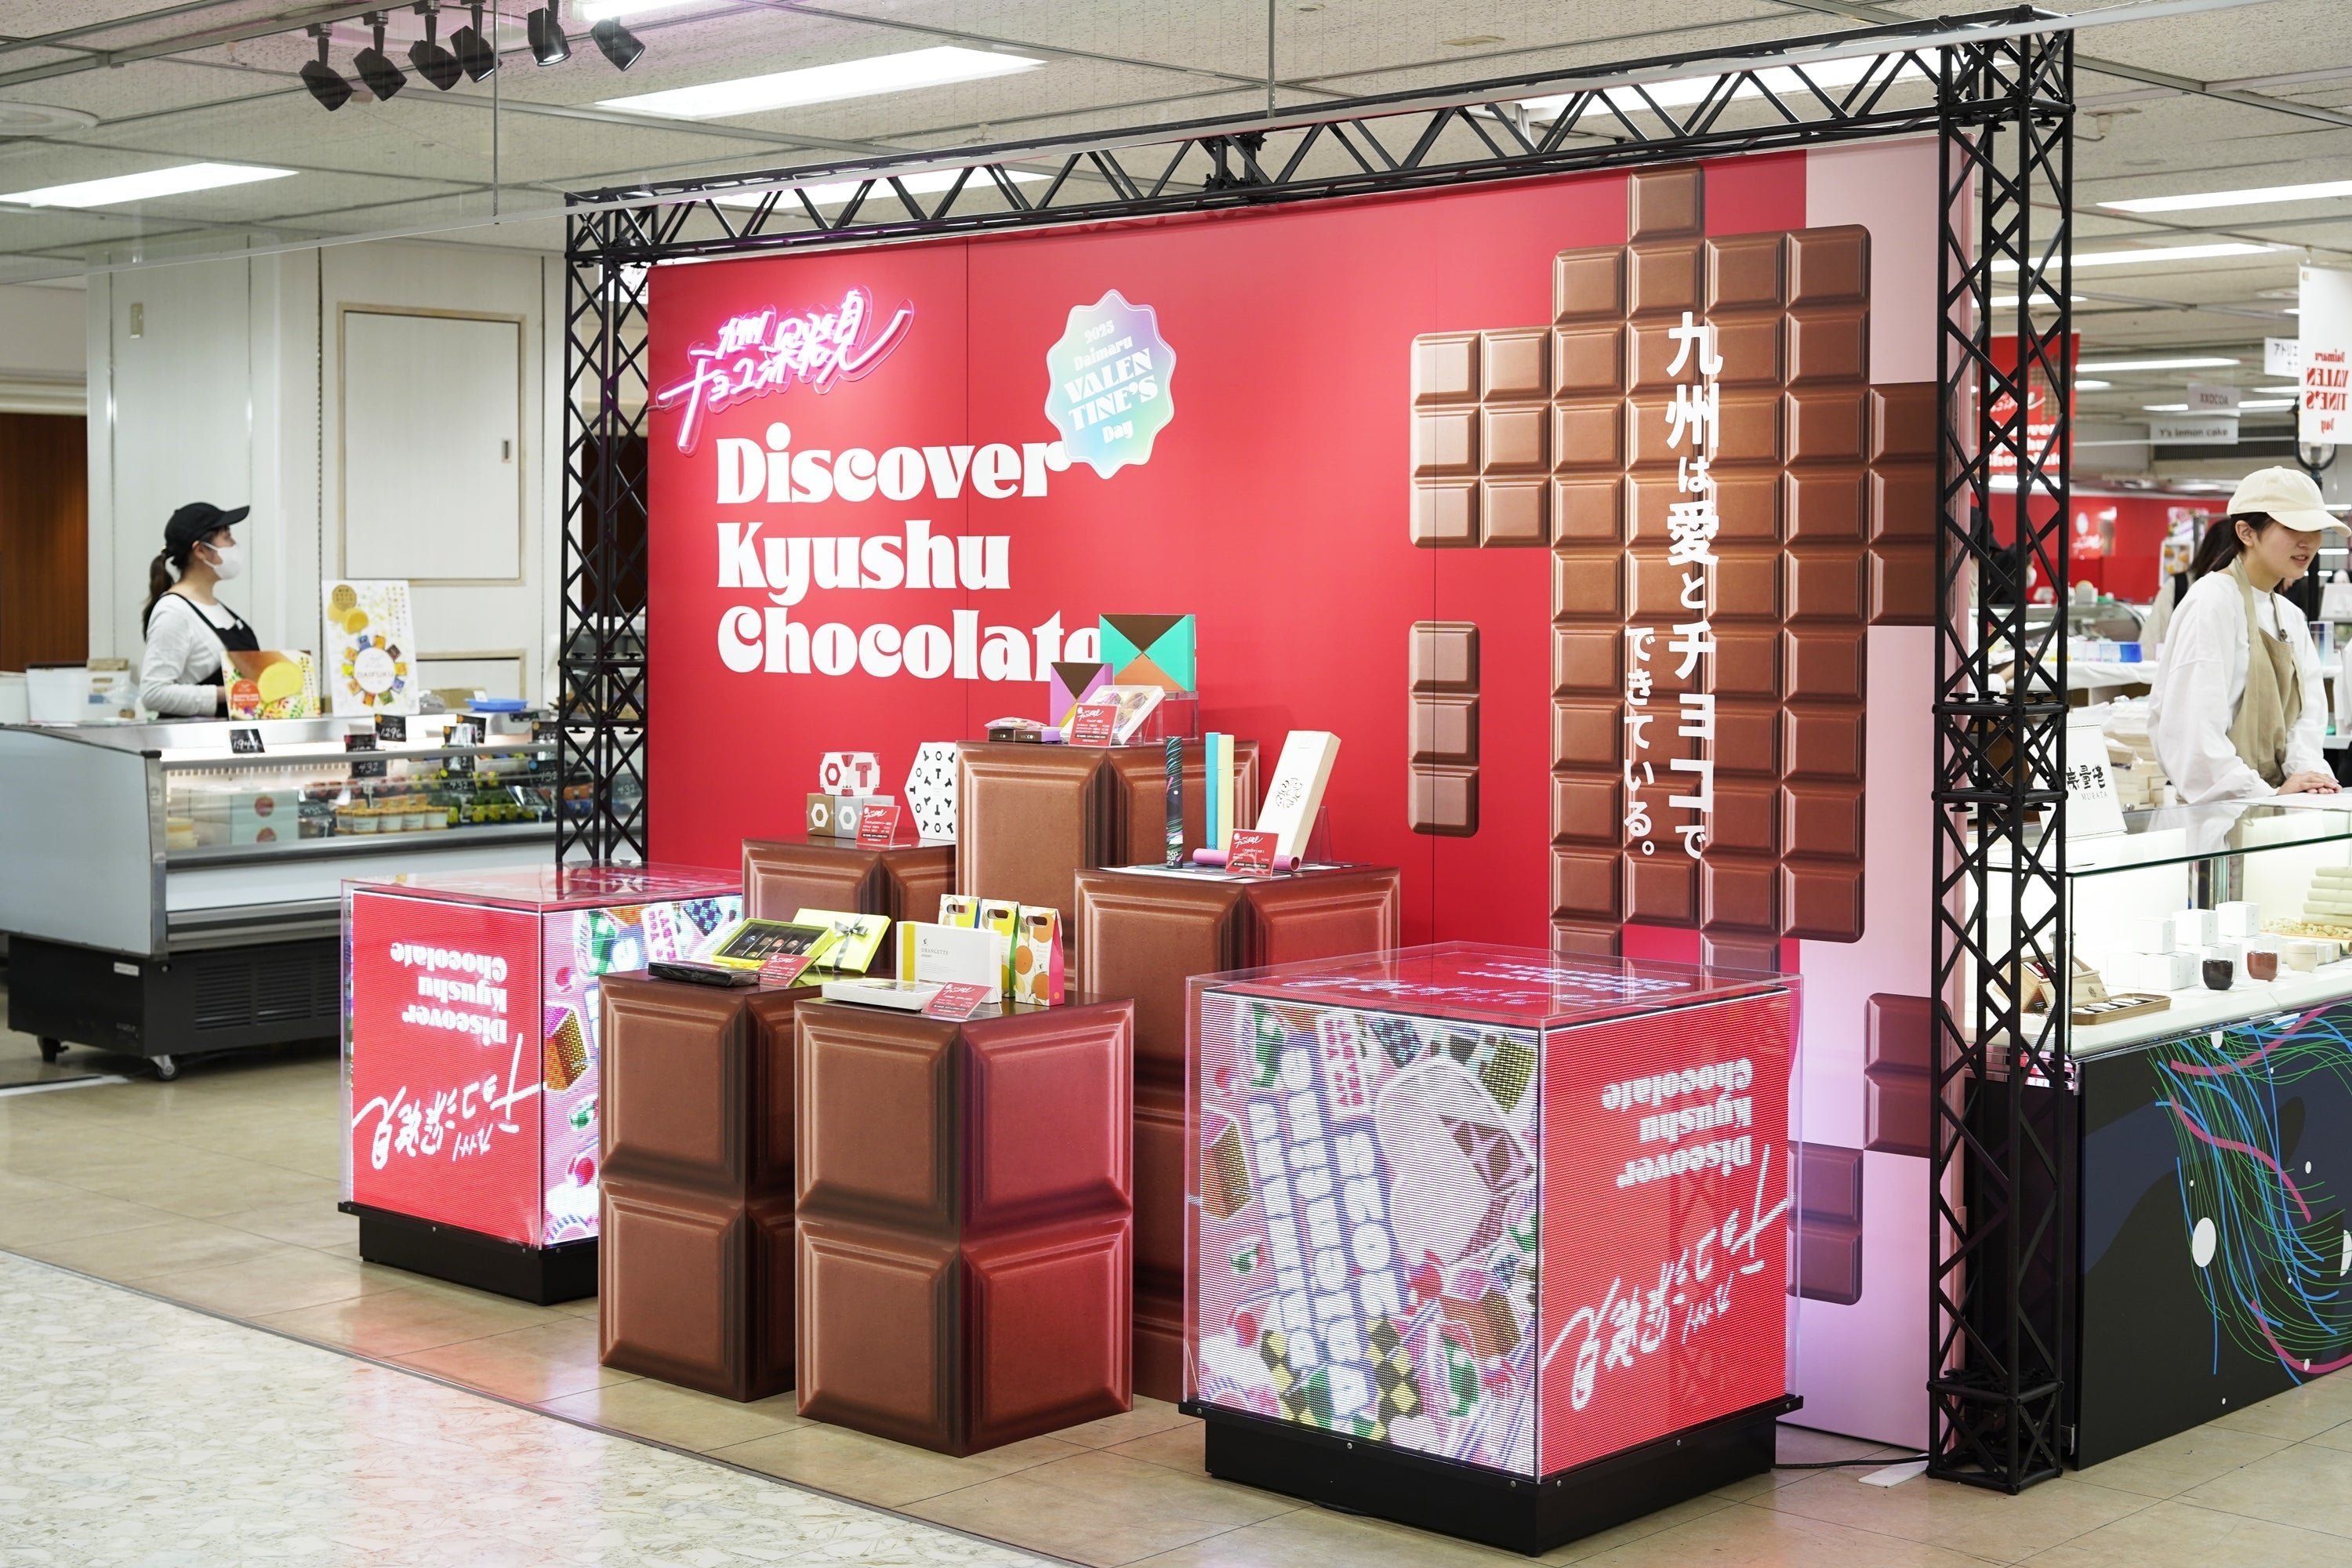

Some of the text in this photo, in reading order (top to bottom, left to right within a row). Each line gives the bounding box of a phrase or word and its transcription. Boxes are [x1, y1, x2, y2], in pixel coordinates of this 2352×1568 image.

[1073, 336, 1133, 372] Daimaru
[1084, 320, 1115, 344] 2025
[1064, 347, 1153, 404] VALEN
[1102, 420, 1134, 444] Day
[2175, 427, 2204, 437] lemon
[2206, 426, 2228, 437] cake
[717, 422, 1073, 504] Discover
[717, 519, 1011, 605] Kyushu
[1664, 310, 1723, 860] 九州は愛とチョコで
[717, 605, 1101, 683] Chocolate
[1623, 626, 1655, 857] できている。
[2082, 791, 2108, 800] MURATA
[390, 942, 508, 981] Chocolate
[921, 947, 949, 956] ORANGETTE
[418, 977, 507, 1013] Kyushu
[401, 1005, 507, 1047] Discover
[1602, 1057, 1753, 1113] Chocolate
[1640, 1093, 1753, 1144] Kyushu
[1616, 1136, 1753, 1189] Discover
